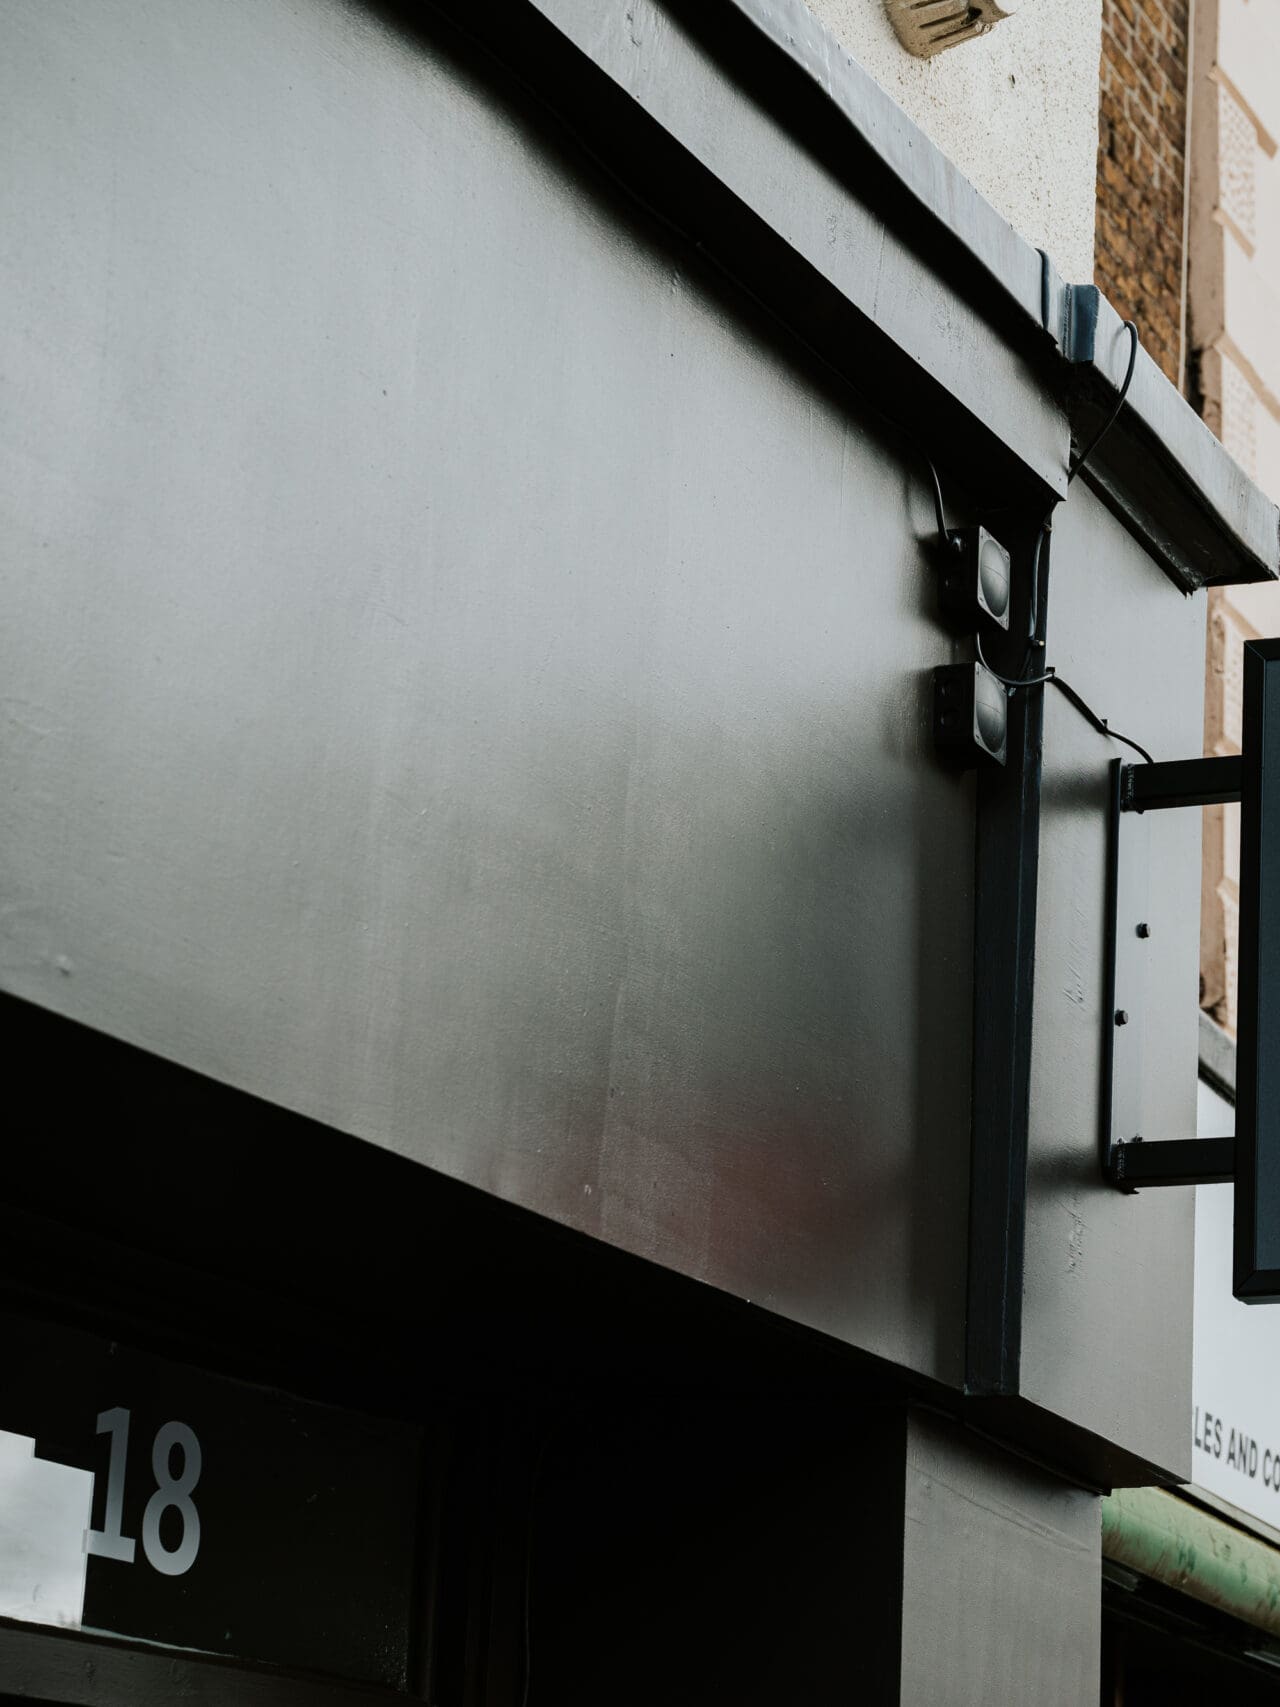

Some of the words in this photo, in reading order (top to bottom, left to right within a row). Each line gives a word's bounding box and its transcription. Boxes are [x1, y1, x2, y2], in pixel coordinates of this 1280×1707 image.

[82, 1406, 202, 1576] 18
[1194, 1405, 1222, 1459] LES
[1226, 1428, 1258, 1478] AND
